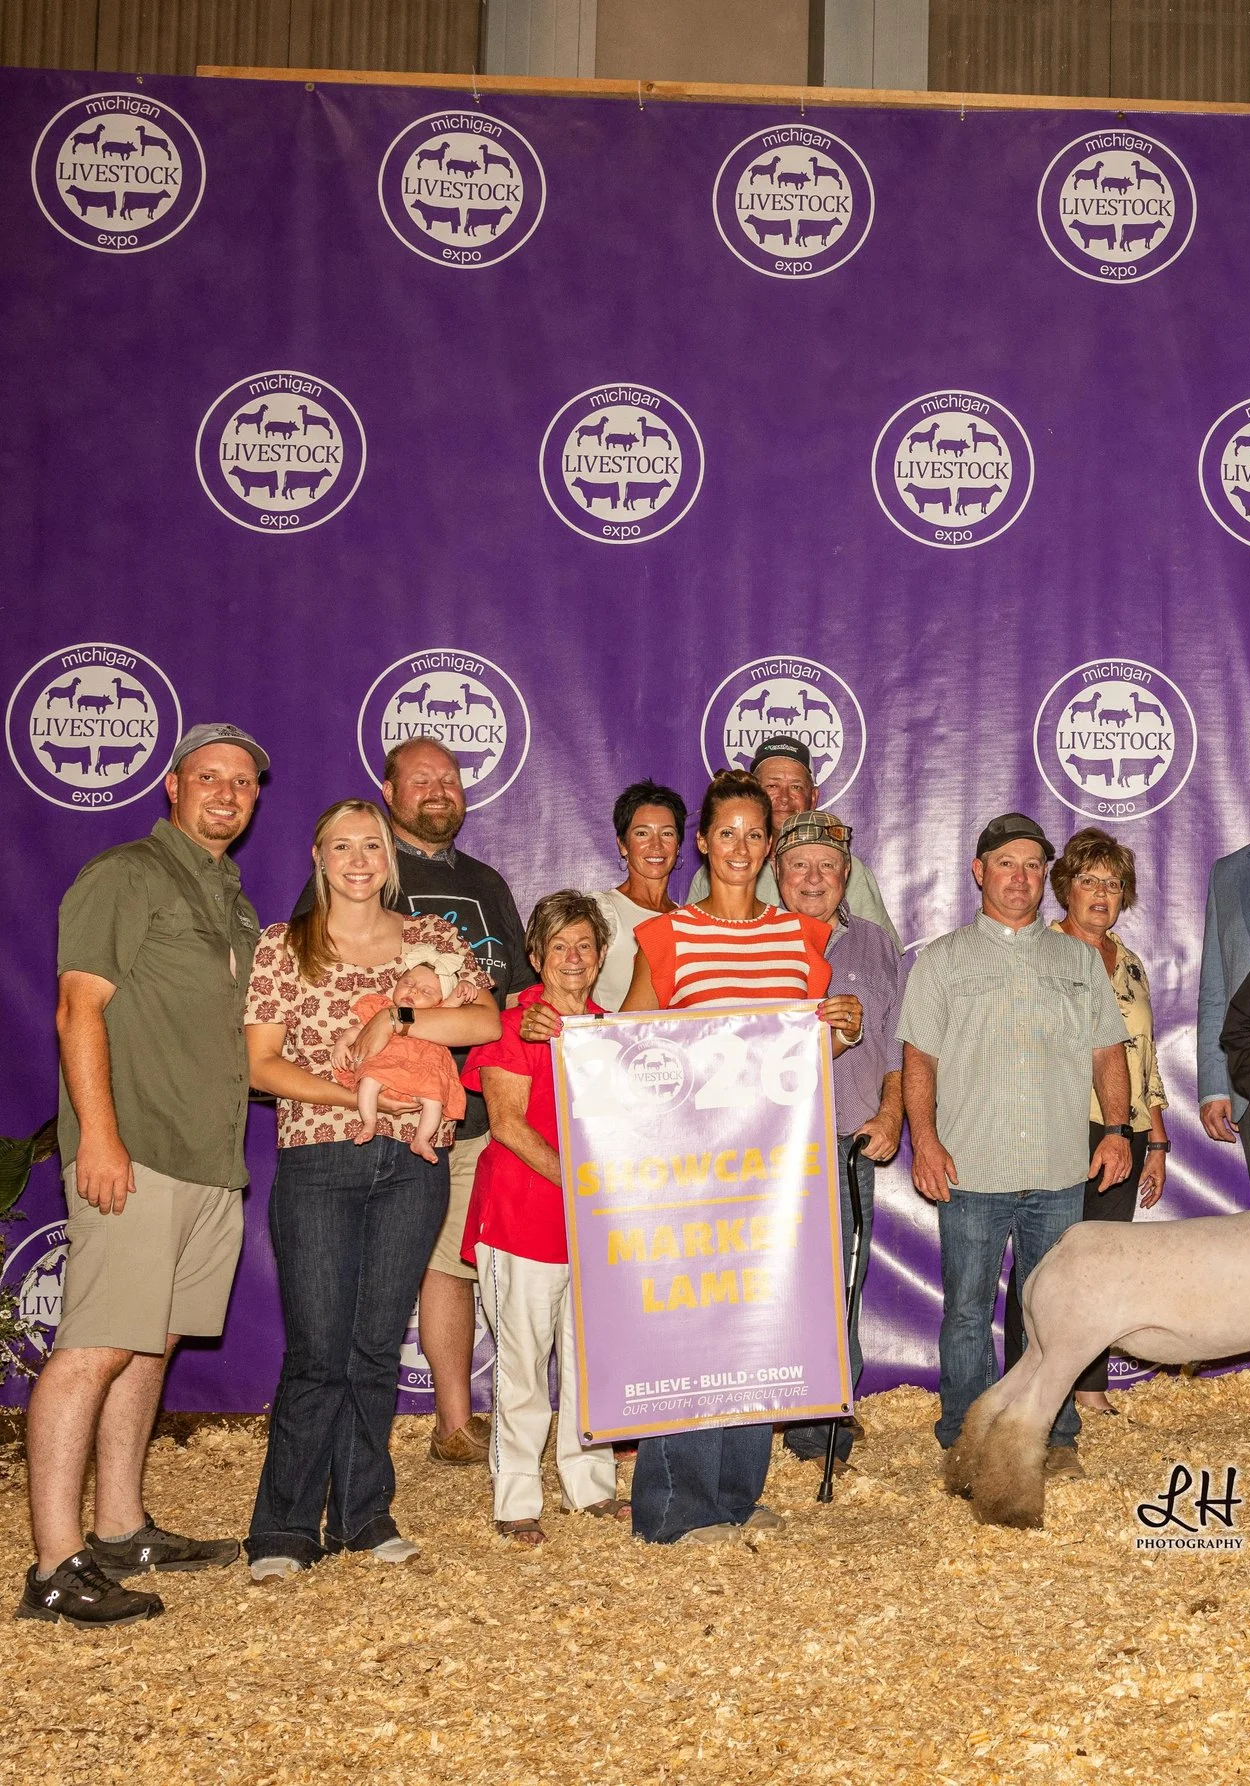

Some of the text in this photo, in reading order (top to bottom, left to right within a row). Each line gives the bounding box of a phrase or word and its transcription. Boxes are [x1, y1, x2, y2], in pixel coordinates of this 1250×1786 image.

[86, 96, 160, 118] michigan
[431, 115, 502, 137] michigan
[763, 129, 831, 149] michigan
[1086, 134, 1152, 153] michigan
[59, 162, 178, 184] LIVESTOCK
[404, 177, 520, 201] LIVESTOCK
[738, 193, 849, 212] LIVESTOCK
[1063, 198, 1172, 216] LIVESTOCK
[98, 234, 138, 249] expo
[443, 249, 481, 264] expo
[775, 261, 812, 274] expo
[1100, 265, 1136, 279] expo
[250, 375, 322, 396] michigan
[590, 388, 660, 408] michigan
[921, 395, 989, 414] michigan
[222, 443, 340, 463] LIVESTOCK
[565, 455, 678, 474] LIVESTOCK
[898, 461, 1008, 479] LIVESTOCK
[260, 515, 299, 529] expo
[603, 525, 640, 539] expo
[935, 530, 972, 544] expo
[62, 648, 136, 669] michigan
[411, 653, 484, 675] michigan
[751, 660, 820, 681] michigan
[1083, 663, 1151, 683] michigan
[32, 718, 155, 737] LIVESTOCK
[1059, 732, 1172, 750] LIVESTOCK
[72, 791, 113, 806] expo
[1097, 801, 1135, 816] expo
[634, 1071, 682, 1082] IVESTOCK
[577, 1145, 821, 1197] SHOWCASE
[607, 1216, 803, 1265] MARKET
[642, 1269, 774, 1313] LAMB
[625, 1366, 803, 1397] BELIEVE BUILD GROW
[623, 1404, 648, 1417] OUR
[697, 1393, 724, 1406] OUR
[725, 1386, 808, 1404] AGRICULTURE
